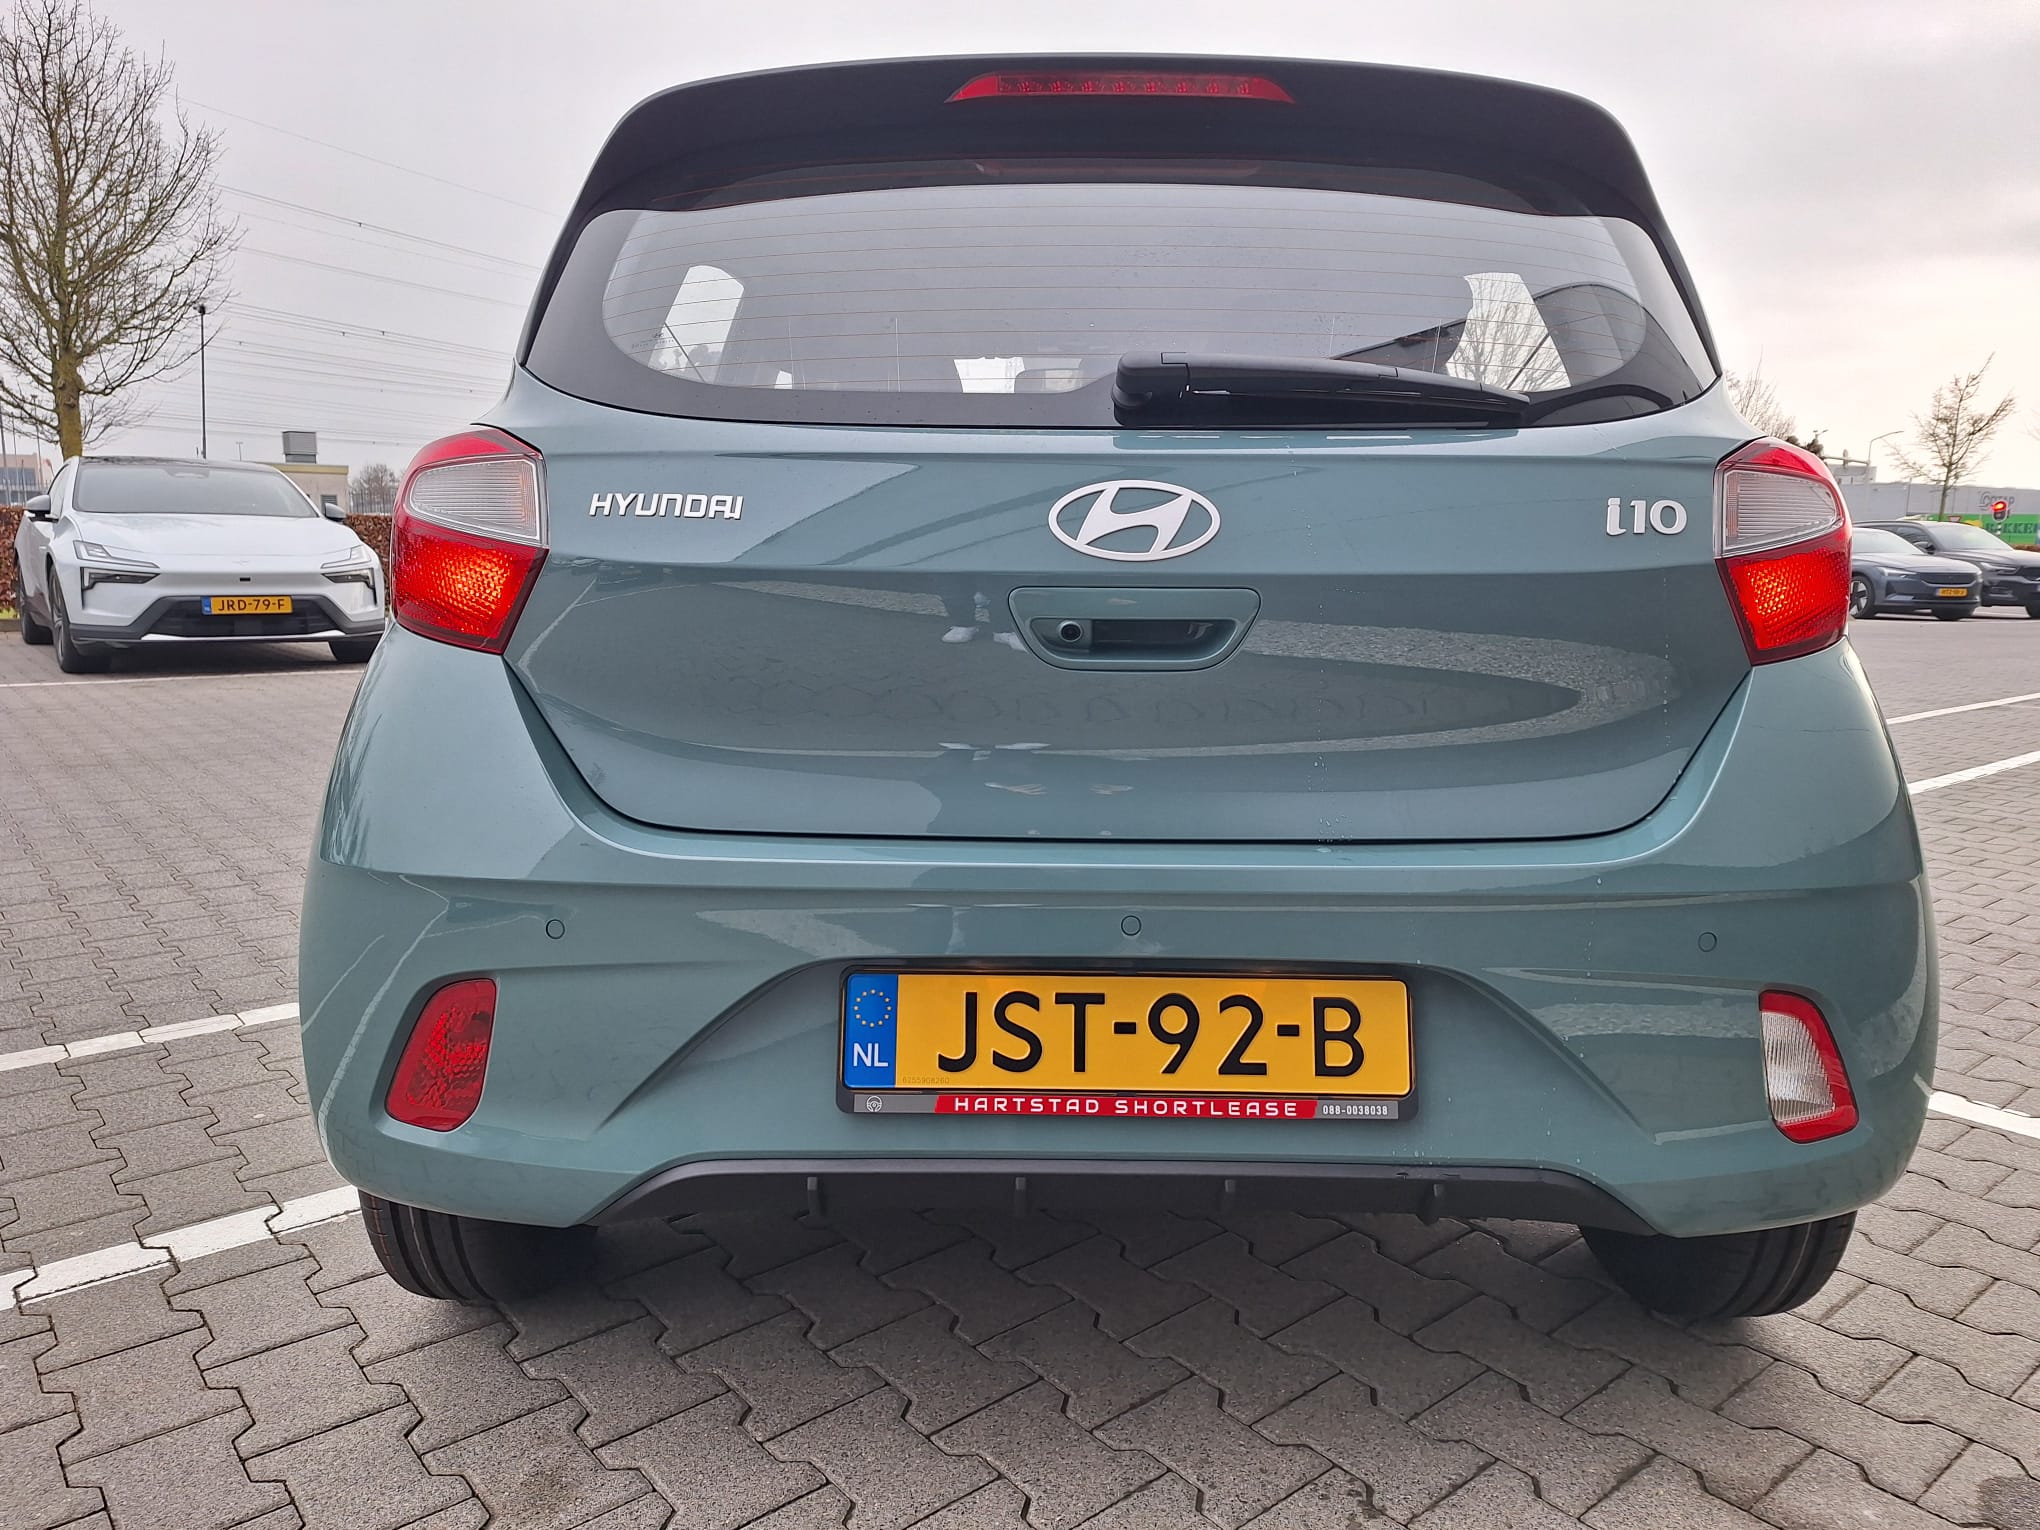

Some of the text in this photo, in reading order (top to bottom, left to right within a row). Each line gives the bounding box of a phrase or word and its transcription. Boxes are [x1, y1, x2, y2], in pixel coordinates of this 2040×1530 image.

[588, 492, 744, 521] HYUNDAI
[1606, 497, 1688, 536] i10
[218, 598, 285, 612] JRD-79-F
[936, 990, 1366, 1078] JST-92-B
[852, 1042, 889, 1068] NL
[954, 1096, 1299, 1117] HARTSTAD SHORTLEASE
